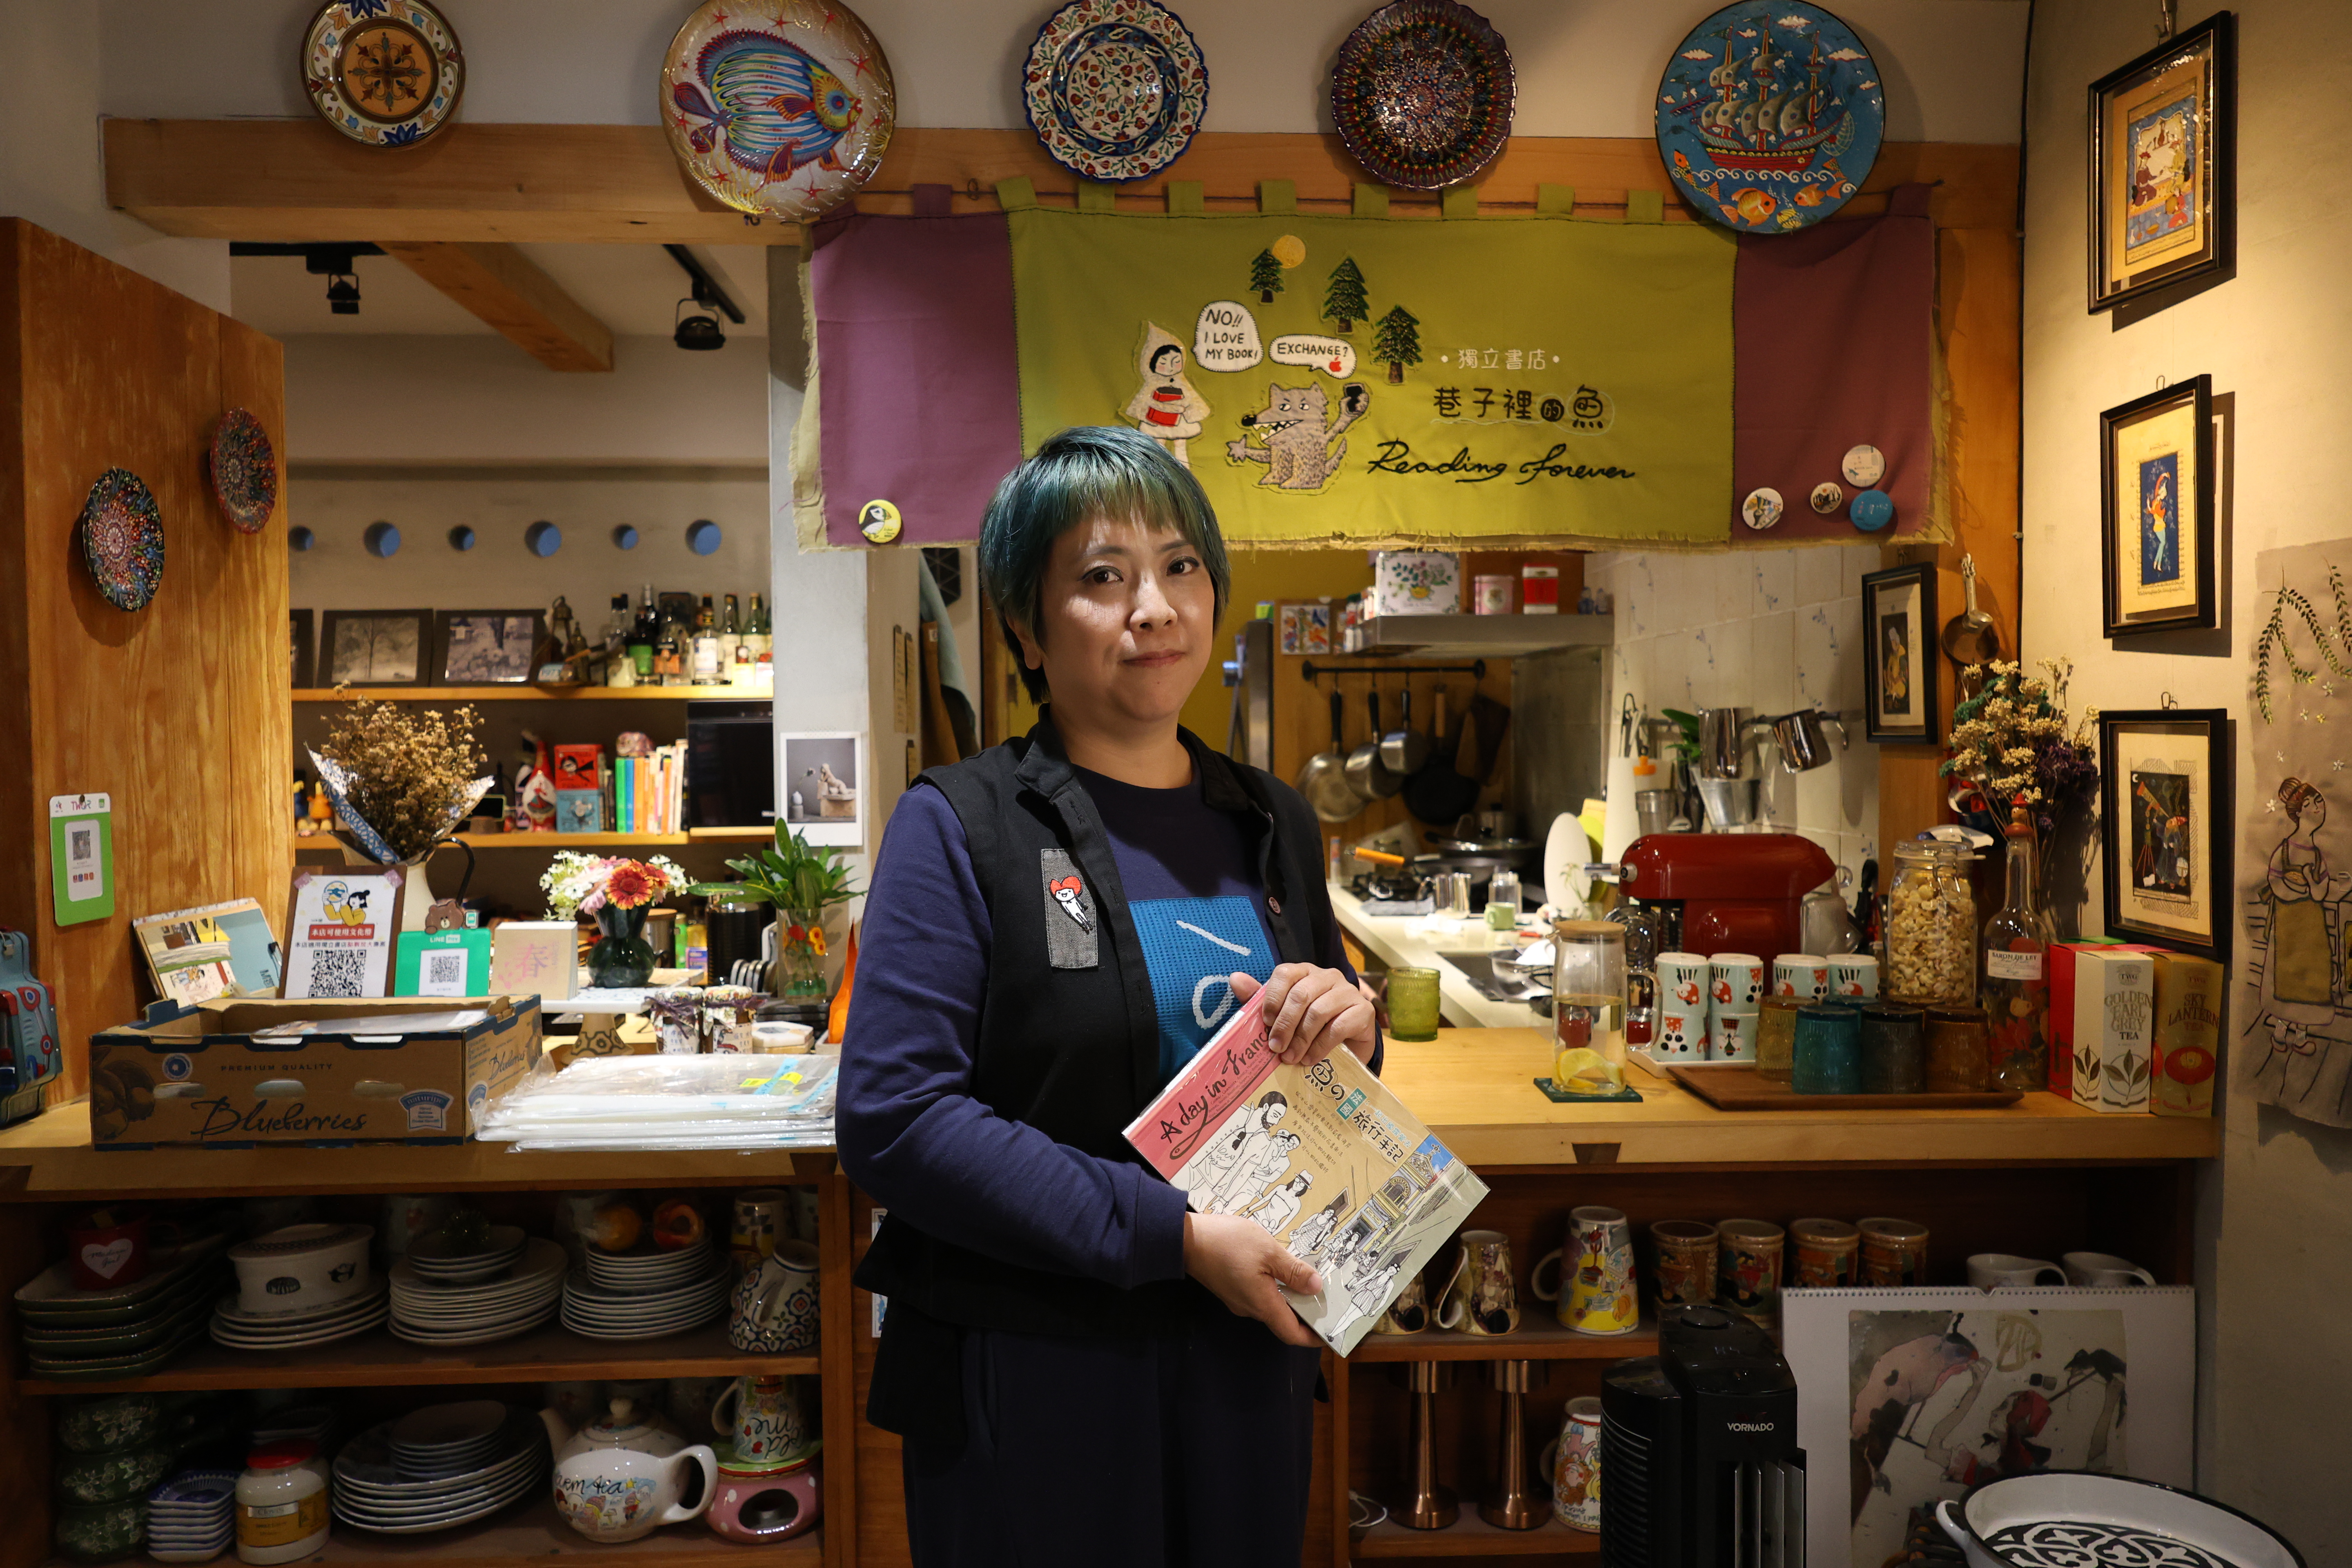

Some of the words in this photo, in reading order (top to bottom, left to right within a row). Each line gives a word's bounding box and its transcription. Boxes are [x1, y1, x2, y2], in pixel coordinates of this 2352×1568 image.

[1205, 309, 1243, 327] NO!!
[1204, 332, 1208, 343] I
[1213, 332, 1245, 344] LOVE
[1205, 348, 1223, 359] MY
[1227, 349, 1258, 360] BOOK!
[1277, 342, 1348, 358] EXCHANGE?
[1458, 348, 1546, 370] 獨立書店
[1433, 384, 1604, 429] 巷子裡的魚
[1368, 437, 1508, 483] Reading
[515, 944, 548, 978] 春
[2104, 990, 2153, 1009] GOLDEN
[2183, 993, 2208, 1007] SKY
[2111, 1003, 2146, 1019] EARL
[2168, 1006, 2220, 1028] LANTERN
[2110, 1018, 2145, 1033] GREY
[2119, 1031, 2139, 1040] TEA
[221, 1063, 275, 1072] PREMIUM
[281, 1063, 333, 1071] QUALITY
[191, 1096, 367, 1140] Blueberries
[1160, 1120, 1183, 1144] A
[1207, 1078, 1227, 1098] in
[1727, 1422, 1774, 1432] VORNADO
